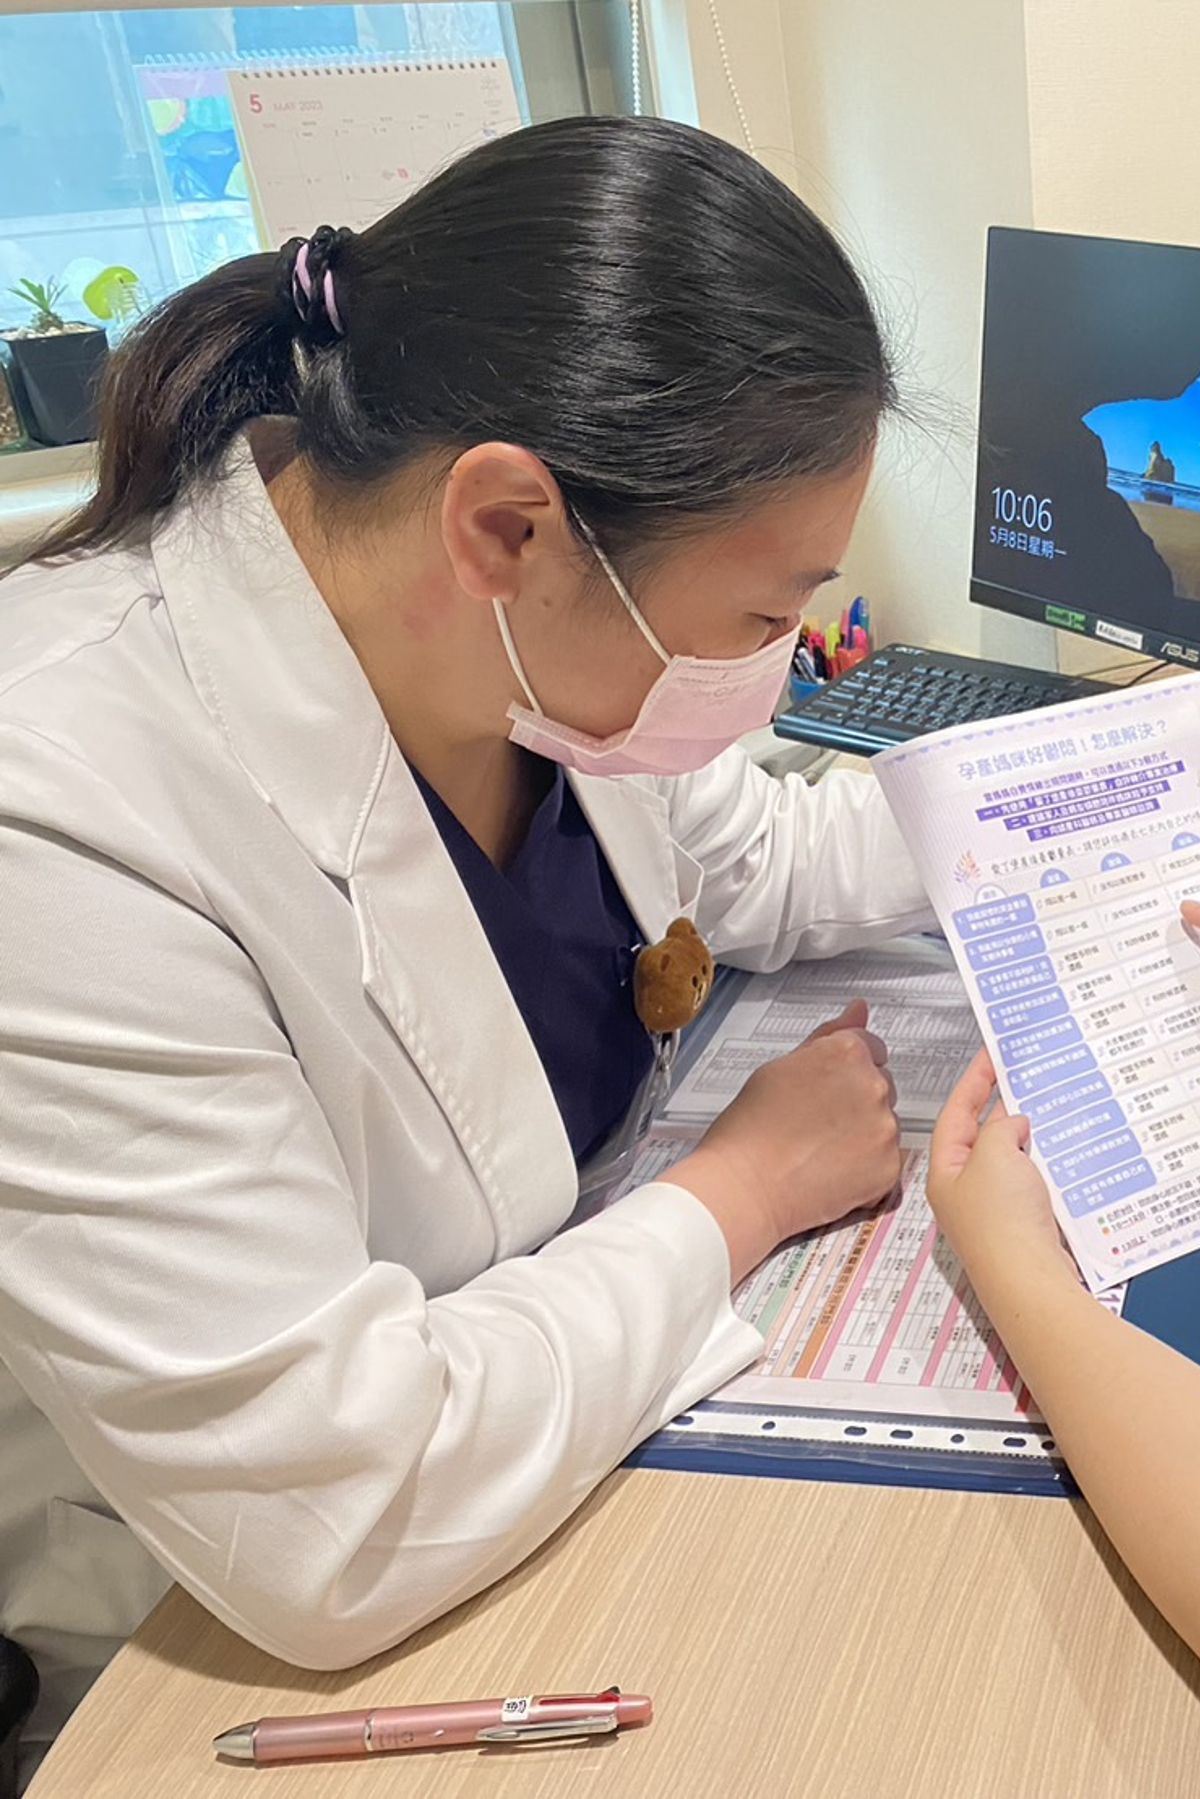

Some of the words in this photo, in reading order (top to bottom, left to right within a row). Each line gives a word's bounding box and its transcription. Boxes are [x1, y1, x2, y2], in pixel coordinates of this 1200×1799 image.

[249, 94, 262, 114] 5
[992, 487, 1052, 533] 10:06
[990, 525, 1067, 560] 5月8日星期一
[1161, 642, 1199, 662] ASUS
